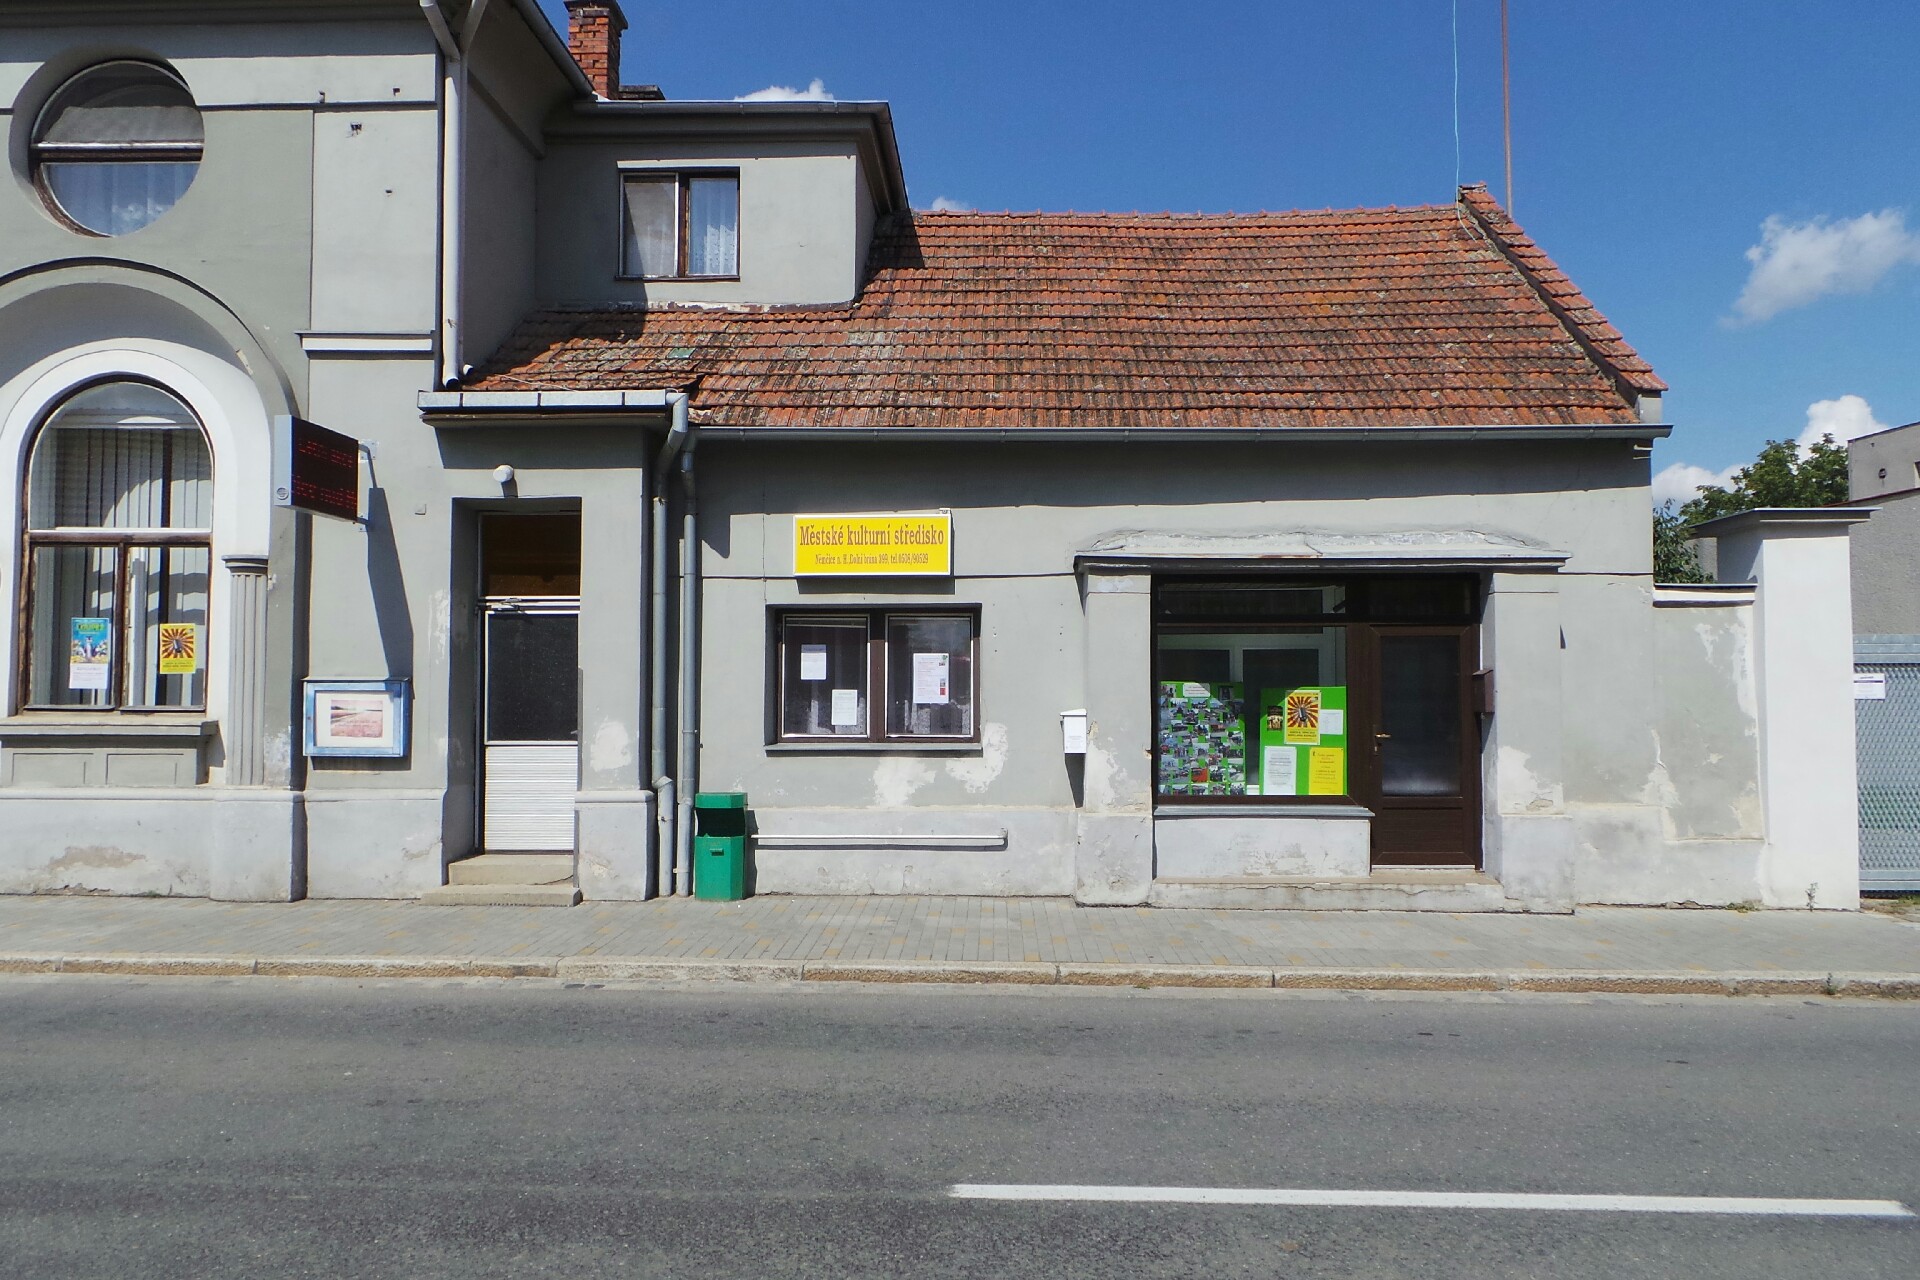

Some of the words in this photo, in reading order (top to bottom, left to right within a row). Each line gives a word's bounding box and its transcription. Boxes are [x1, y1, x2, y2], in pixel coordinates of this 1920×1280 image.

[800, 524, 844, 546] Městské
[847, 524, 891, 546] kulturní
[894, 523, 944, 545] středisko
